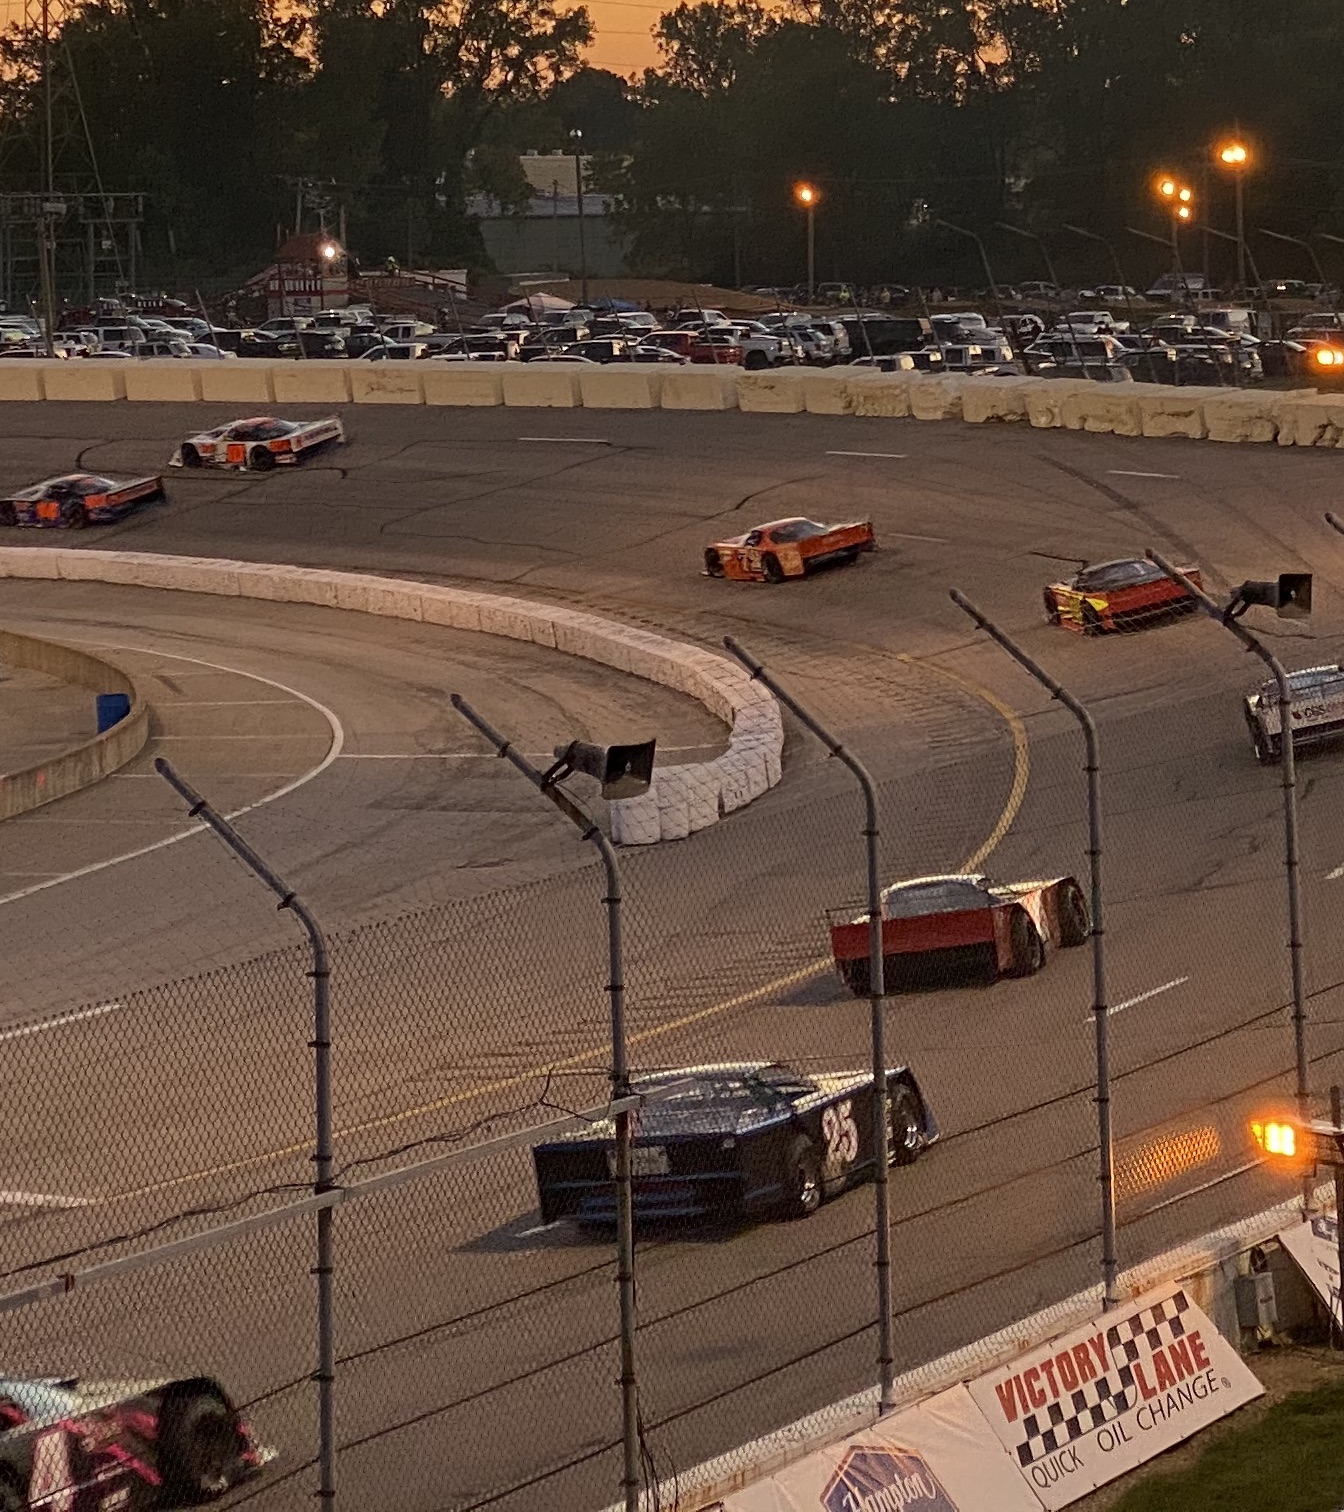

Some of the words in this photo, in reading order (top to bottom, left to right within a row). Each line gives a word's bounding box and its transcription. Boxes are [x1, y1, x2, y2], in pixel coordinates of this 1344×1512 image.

[995, 1332, 1111, 1424] VICTORY
[1133, 1330, 1211, 1402] LANE
[1031, 1445, 1085, 1489] QUICK
[1097, 1420, 1134, 1453] OIL
[1136, 1368, 1220, 1431] CHANGE
